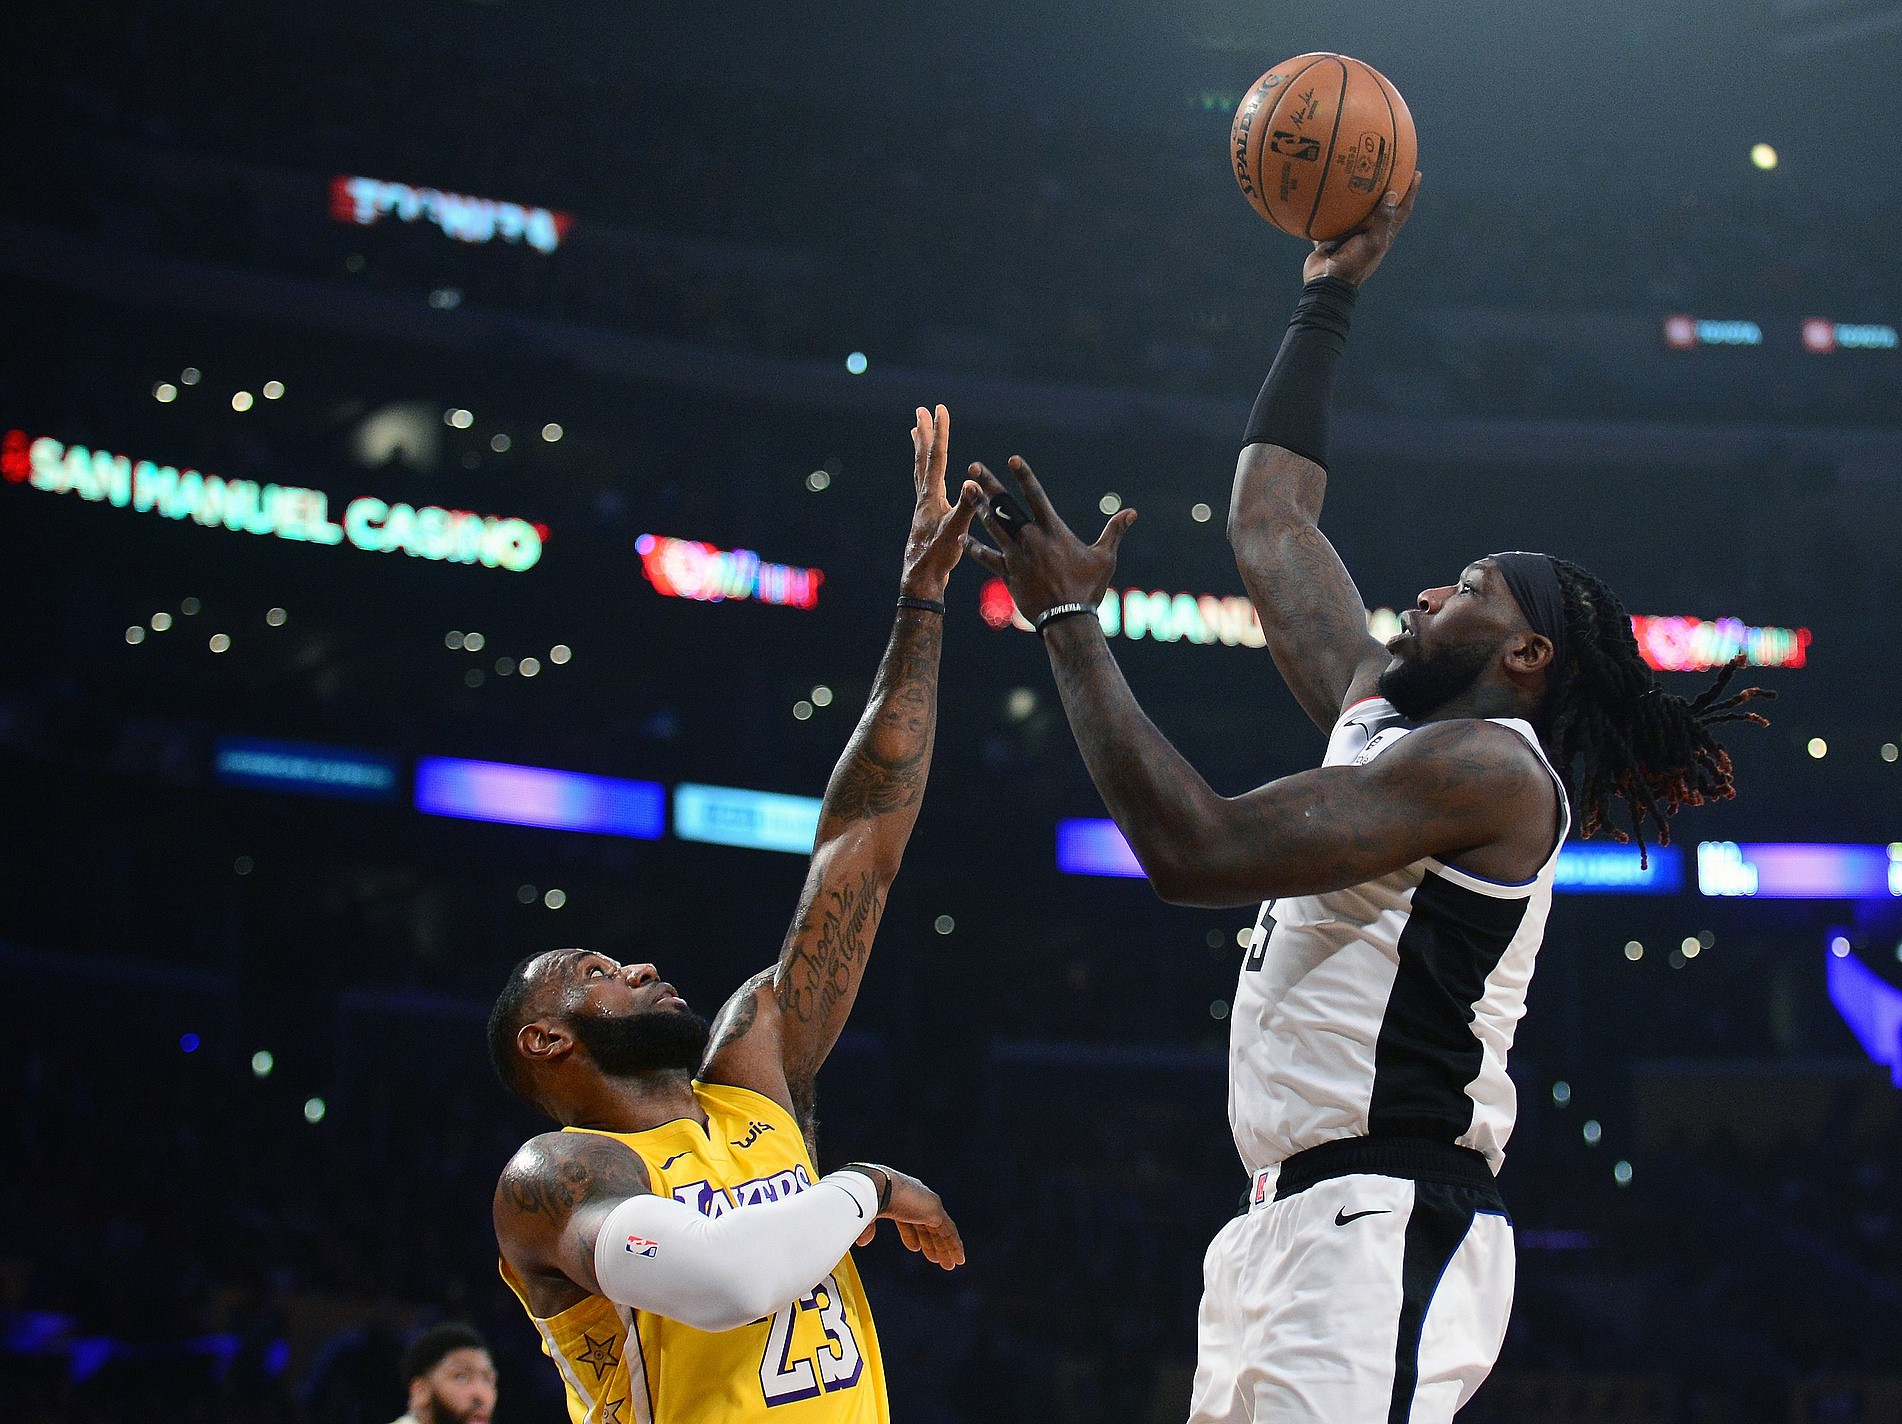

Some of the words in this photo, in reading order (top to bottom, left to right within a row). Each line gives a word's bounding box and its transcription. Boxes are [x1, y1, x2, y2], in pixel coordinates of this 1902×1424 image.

[1235, 72, 1292, 200] SPALDING
[29, 437, 132, 507] SAN
[133, 459, 345, 546] MANUEL
[345, 495, 543, 573] CASINO
[1246, 899, 1278, 972] 5
[758, 1272, 864, 1409] 23
